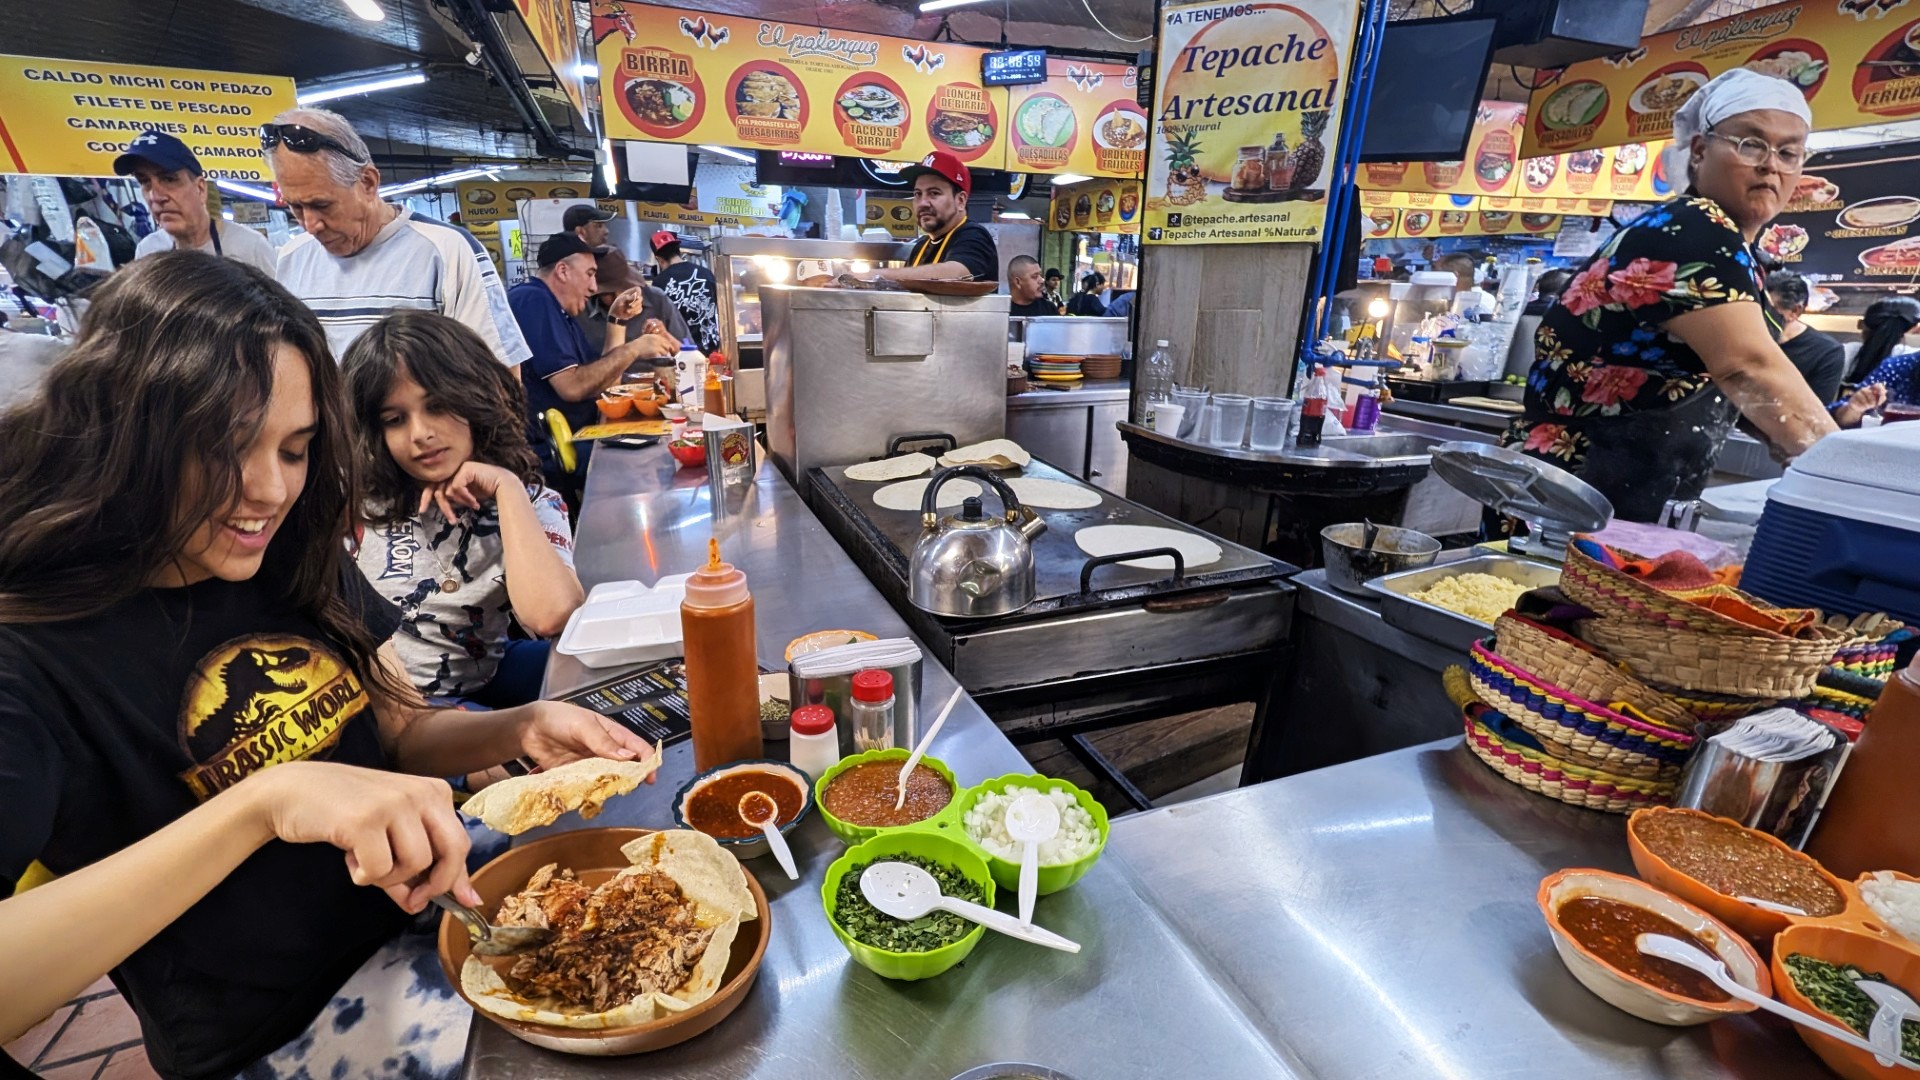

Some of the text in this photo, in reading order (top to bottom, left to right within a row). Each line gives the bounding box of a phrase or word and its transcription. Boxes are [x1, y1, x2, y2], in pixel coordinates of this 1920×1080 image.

[1182, 33, 1328, 78] Tepache
[626, 54, 689, 76] BIRRIA
[24, 68, 273, 96] CALDO MICHI CON PEDAZO
[946, 88, 982, 100] LONCHE
[1158, 79, 1339, 122] Artesanal
[73, 95, 251, 116] FILETE DE PESCADO
[941, 98, 987, 111] DE BIRRIA
[67, 117, 187, 134] CAMARONES
[192, 124, 212, 135] AL
[739, 126, 800, 140] QUESABIRRIAS
[850, 124, 898, 138] TACOS DE
[857, 136, 892, 147] BIRRIA
[1019, 147, 1068, 160] QUESADILLAS
[1102, 149, 1143, 160] ORDEN DE
[1103, 160, 1140, 170] FRIJOLES
[468, 207, 499, 216] HUEVOS
[643, 210, 670, 219] FLAUTAS
[1182, 212, 1290, 227] @tepache.artesanal
[1164, 229, 1206, 240] Tepache
[1208, 226, 1261, 238] Artesanal
[290, 677, 362, 736] WORL
